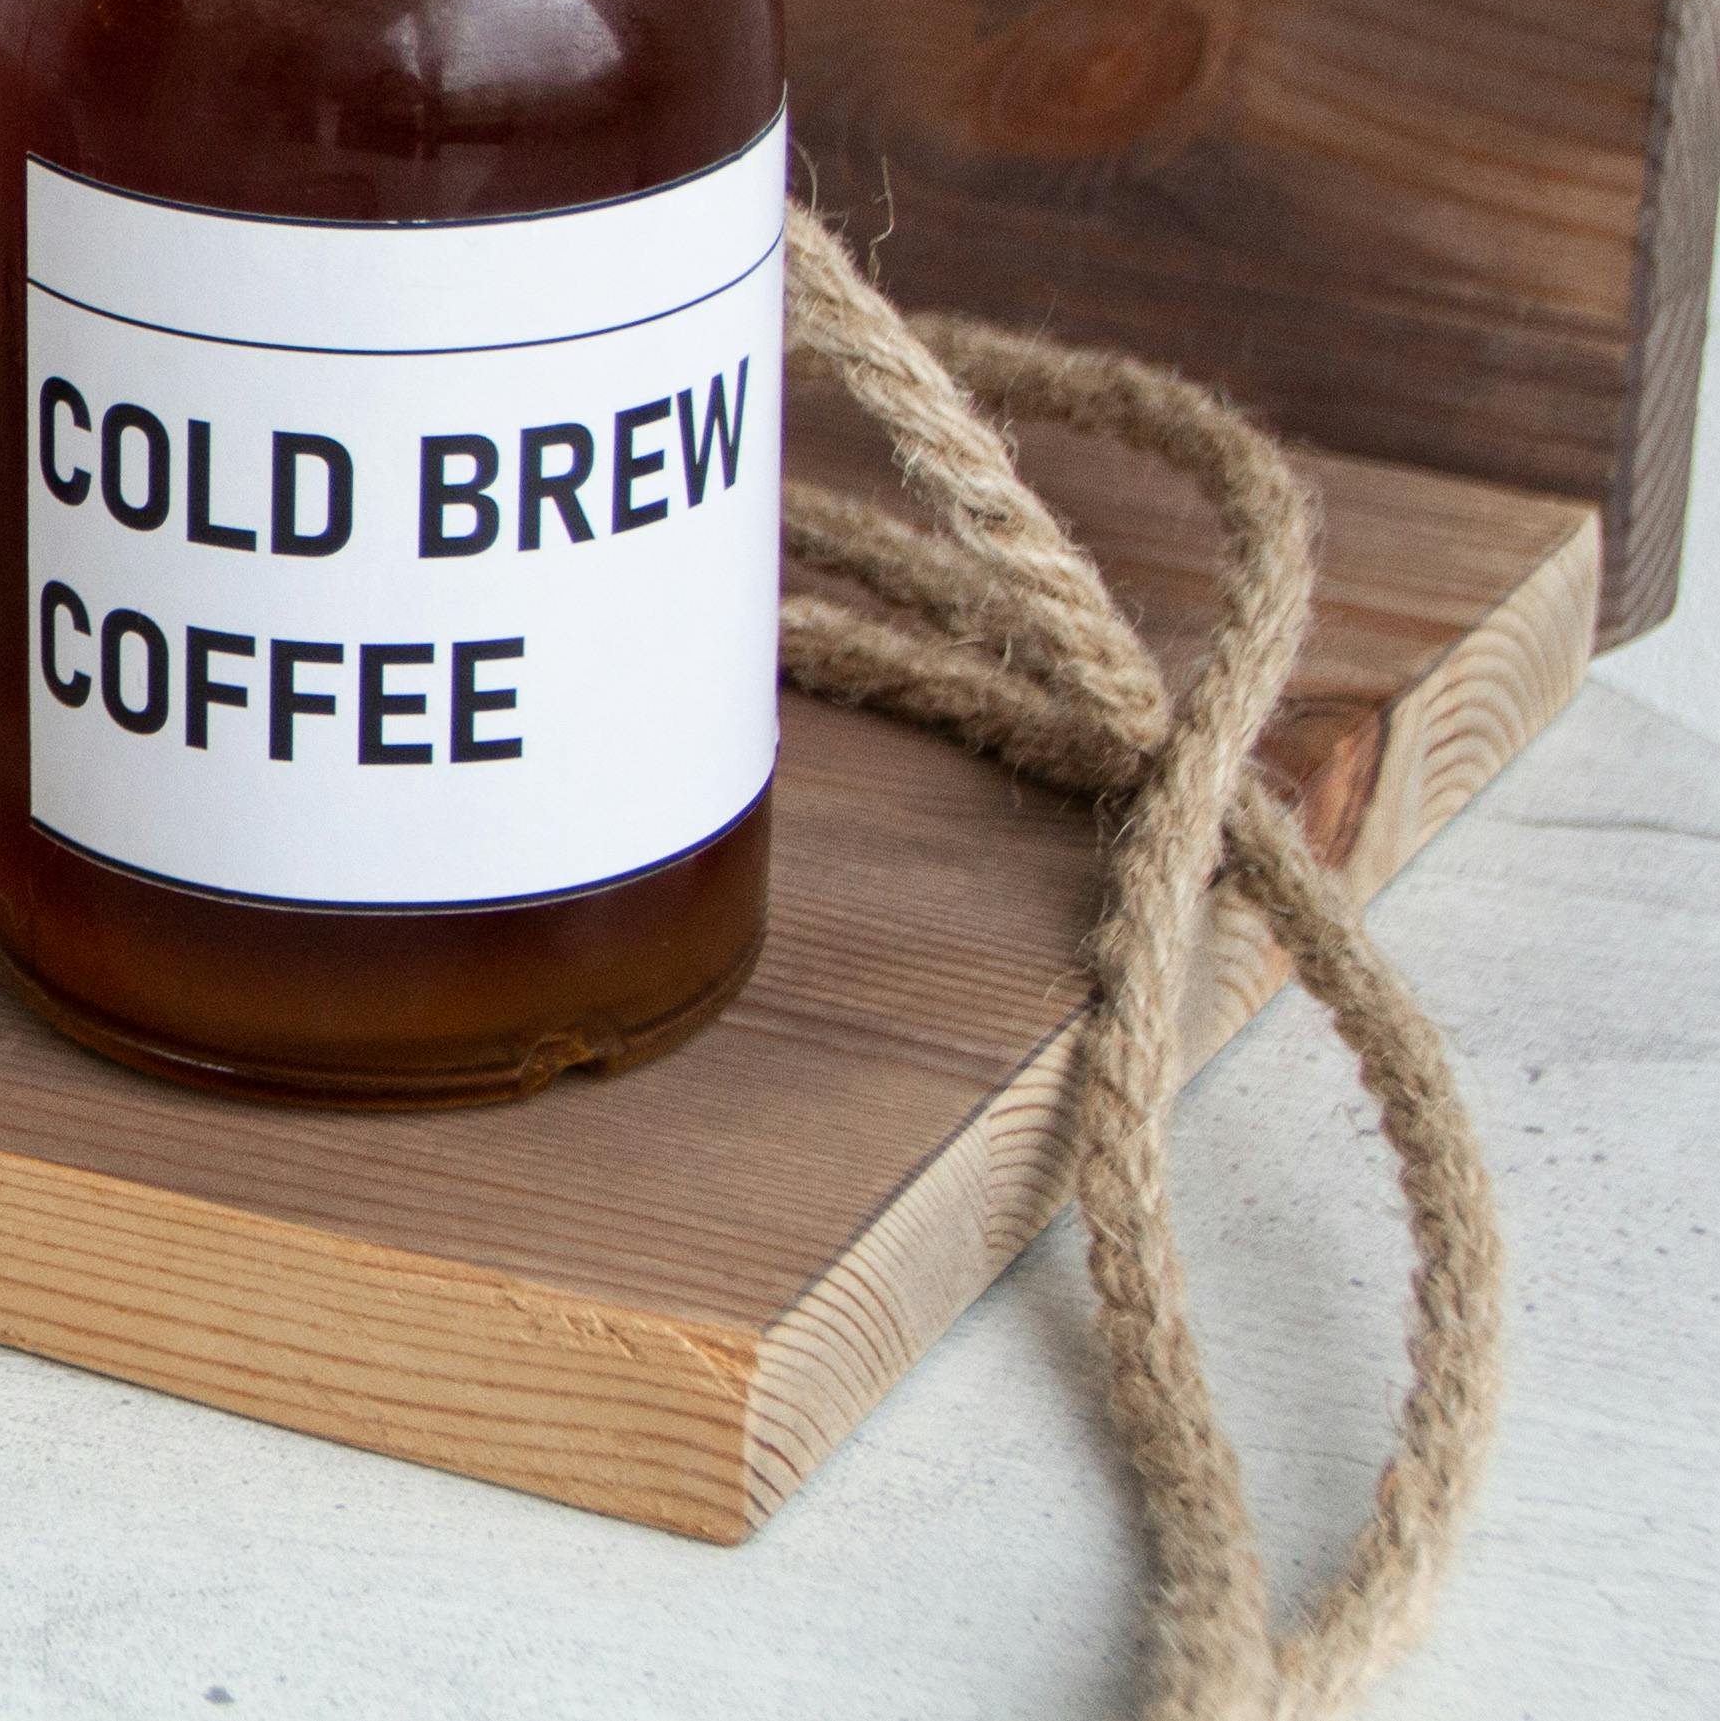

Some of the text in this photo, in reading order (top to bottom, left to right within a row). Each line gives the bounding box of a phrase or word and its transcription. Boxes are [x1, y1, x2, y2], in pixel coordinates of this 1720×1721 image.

[38, 356, 750, 560] COLD BREW
[38, 578, 526, 766] COFFEE
